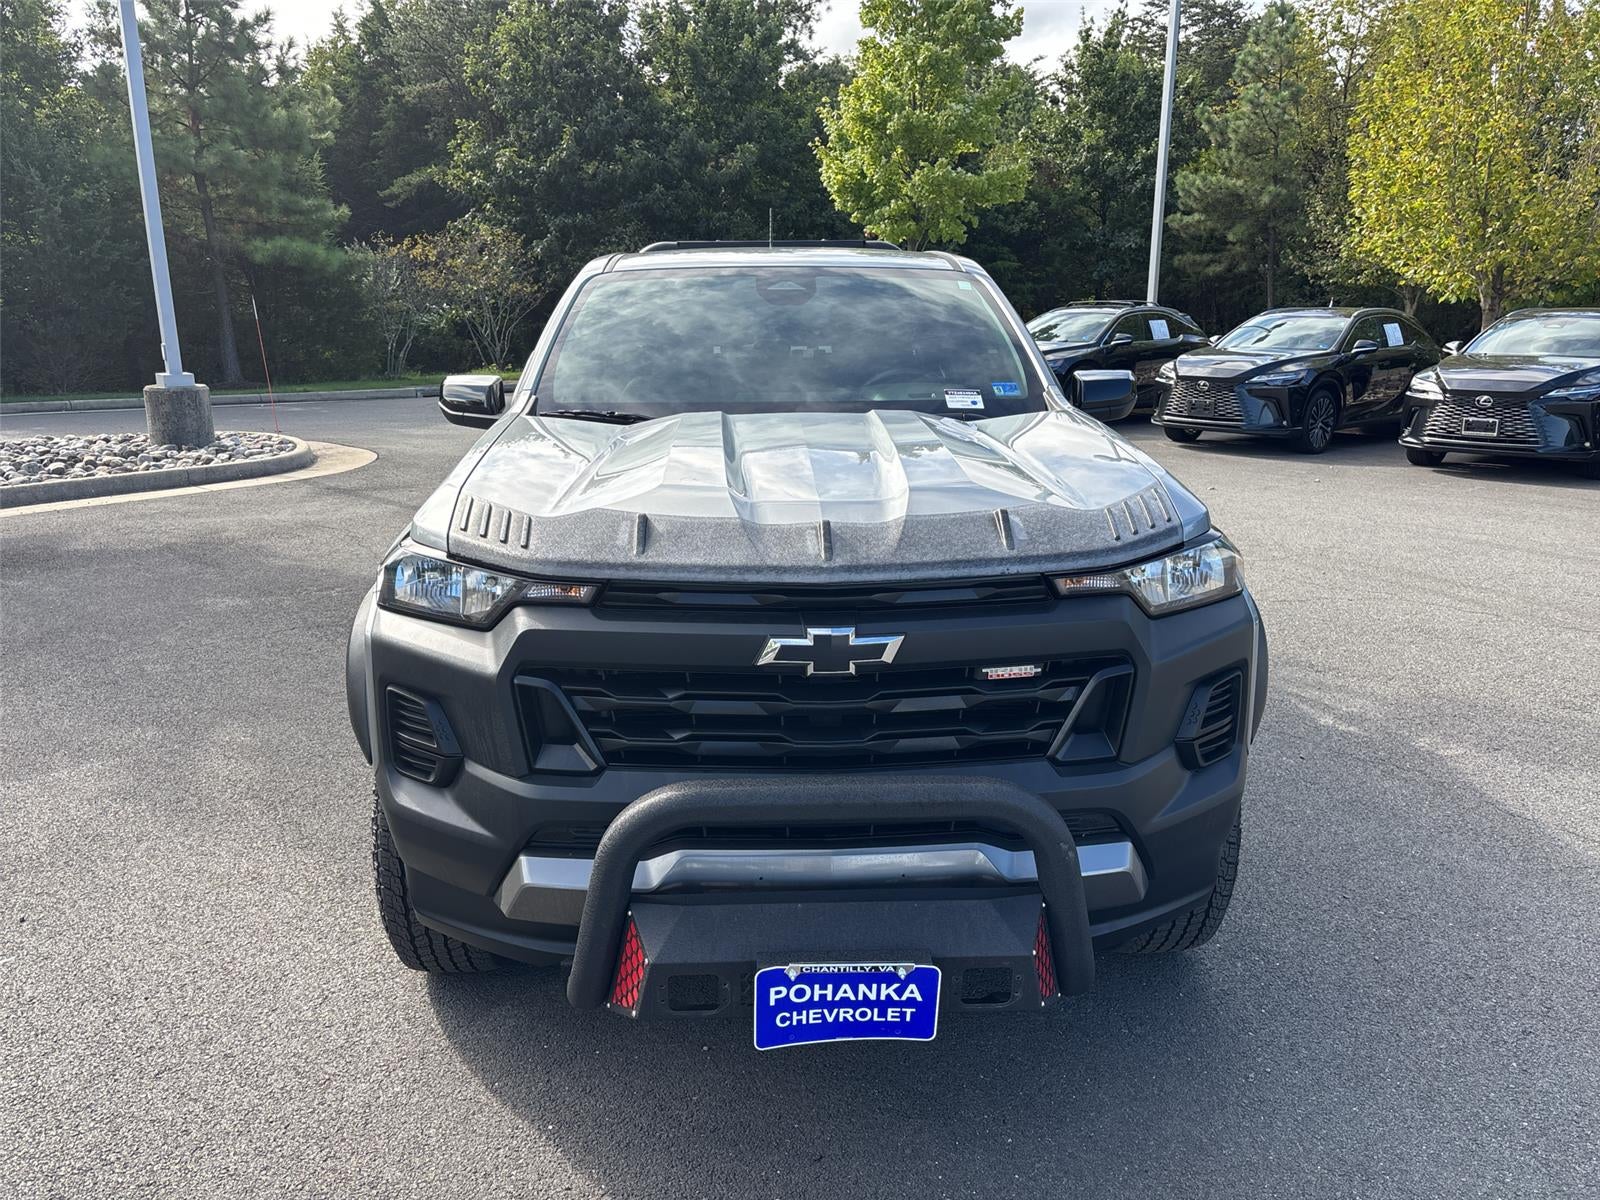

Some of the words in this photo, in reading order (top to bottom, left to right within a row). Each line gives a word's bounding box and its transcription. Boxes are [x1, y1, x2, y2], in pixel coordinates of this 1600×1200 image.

[878, 965, 895, 973] VA
[769, 983, 923, 1007] POHANKA
[775, 1007, 916, 1028] CHEVROLET
